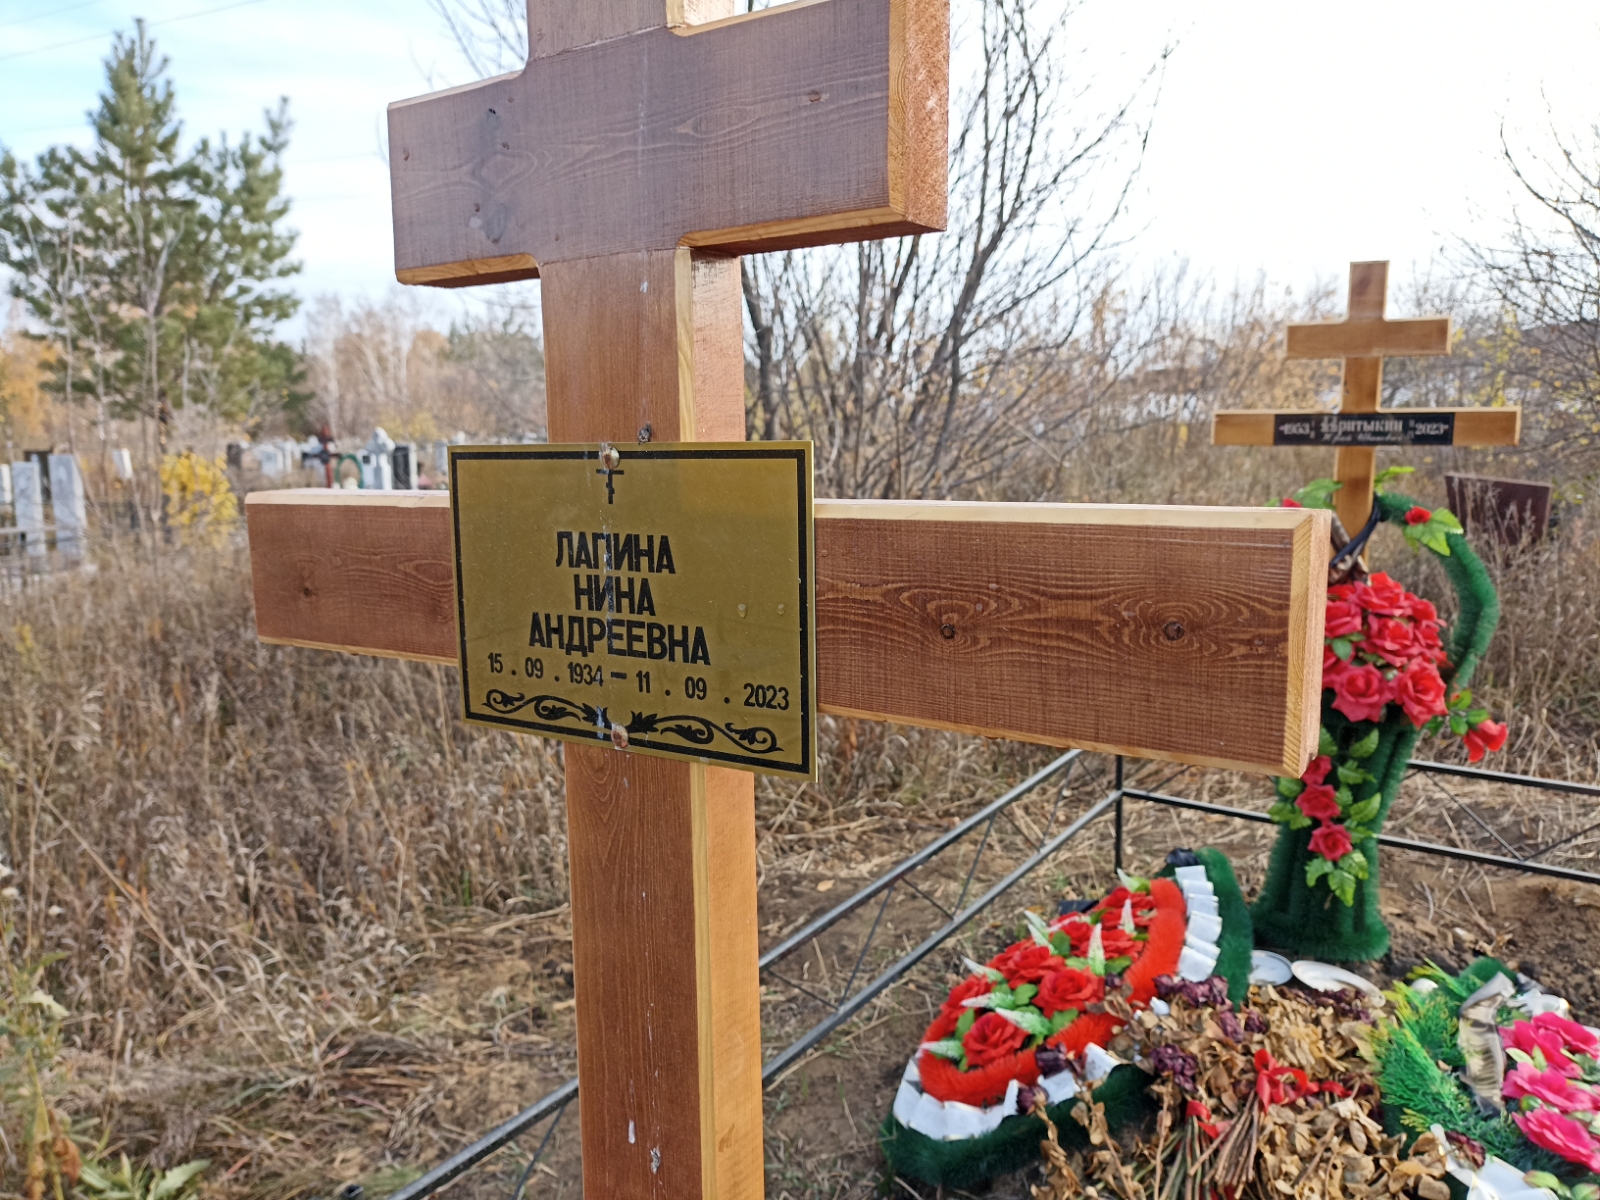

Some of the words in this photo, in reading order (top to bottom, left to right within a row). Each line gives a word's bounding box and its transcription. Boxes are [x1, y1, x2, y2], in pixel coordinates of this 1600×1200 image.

[555, 531, 676, 575] ЛАПИНА
[573, 573, 656, 616] НИНА
[528, 611, 711, 666] АНДРЕЕВНА
